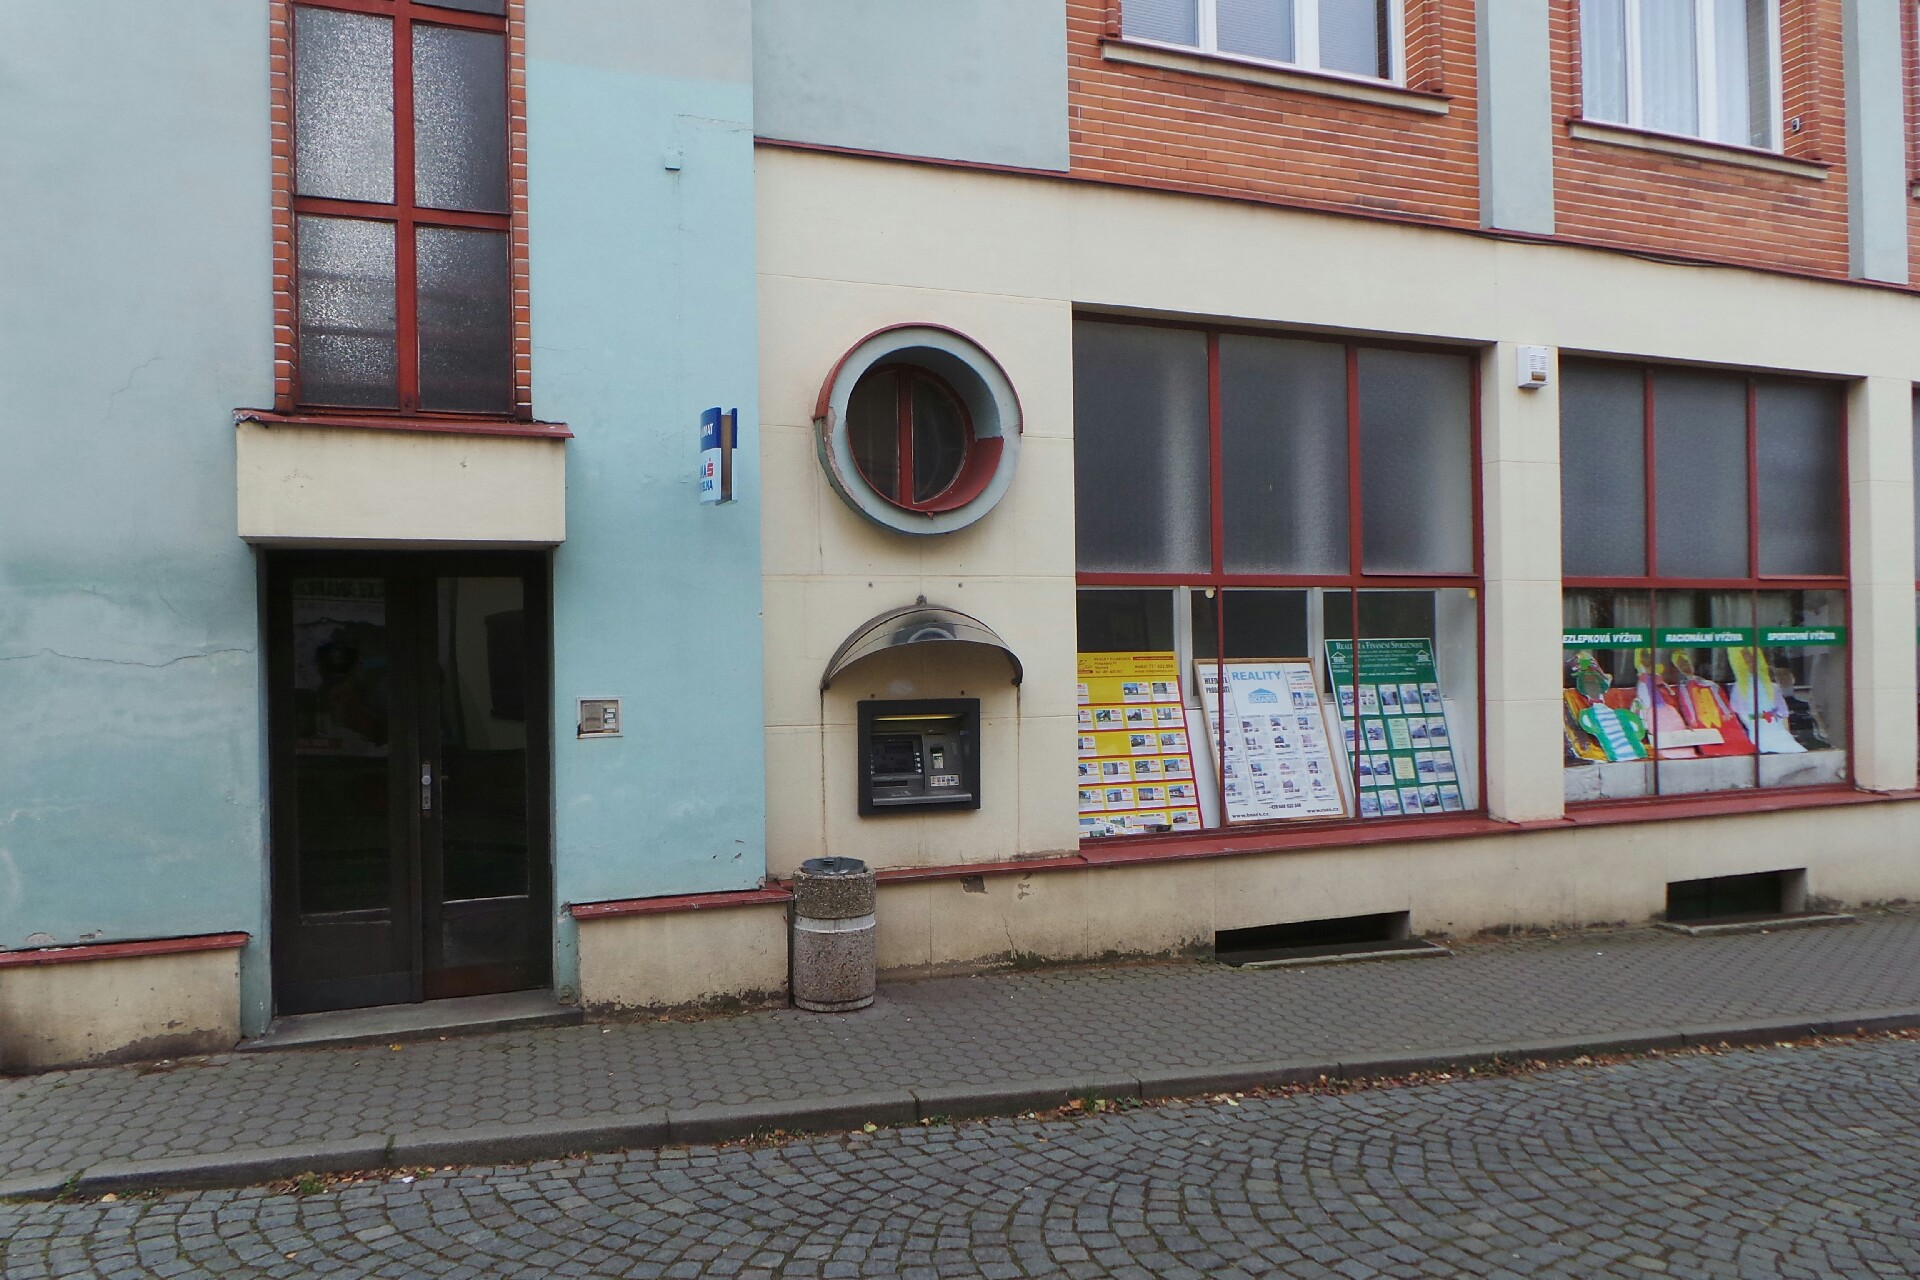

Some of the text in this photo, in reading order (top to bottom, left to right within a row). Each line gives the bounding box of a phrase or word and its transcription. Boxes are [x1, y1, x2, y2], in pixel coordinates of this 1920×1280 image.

[1563, 632, 1643, 644] EZLEPKOVÁ VÝŽIVA
[1665, 631, 1744, 643] RACIONÁLNÍ VÝŽIVA
[1767, 630, 1836, 641] SPORTOVNÍ VÝŽIVA
[1231, 671, 1281, 681] REALITY
